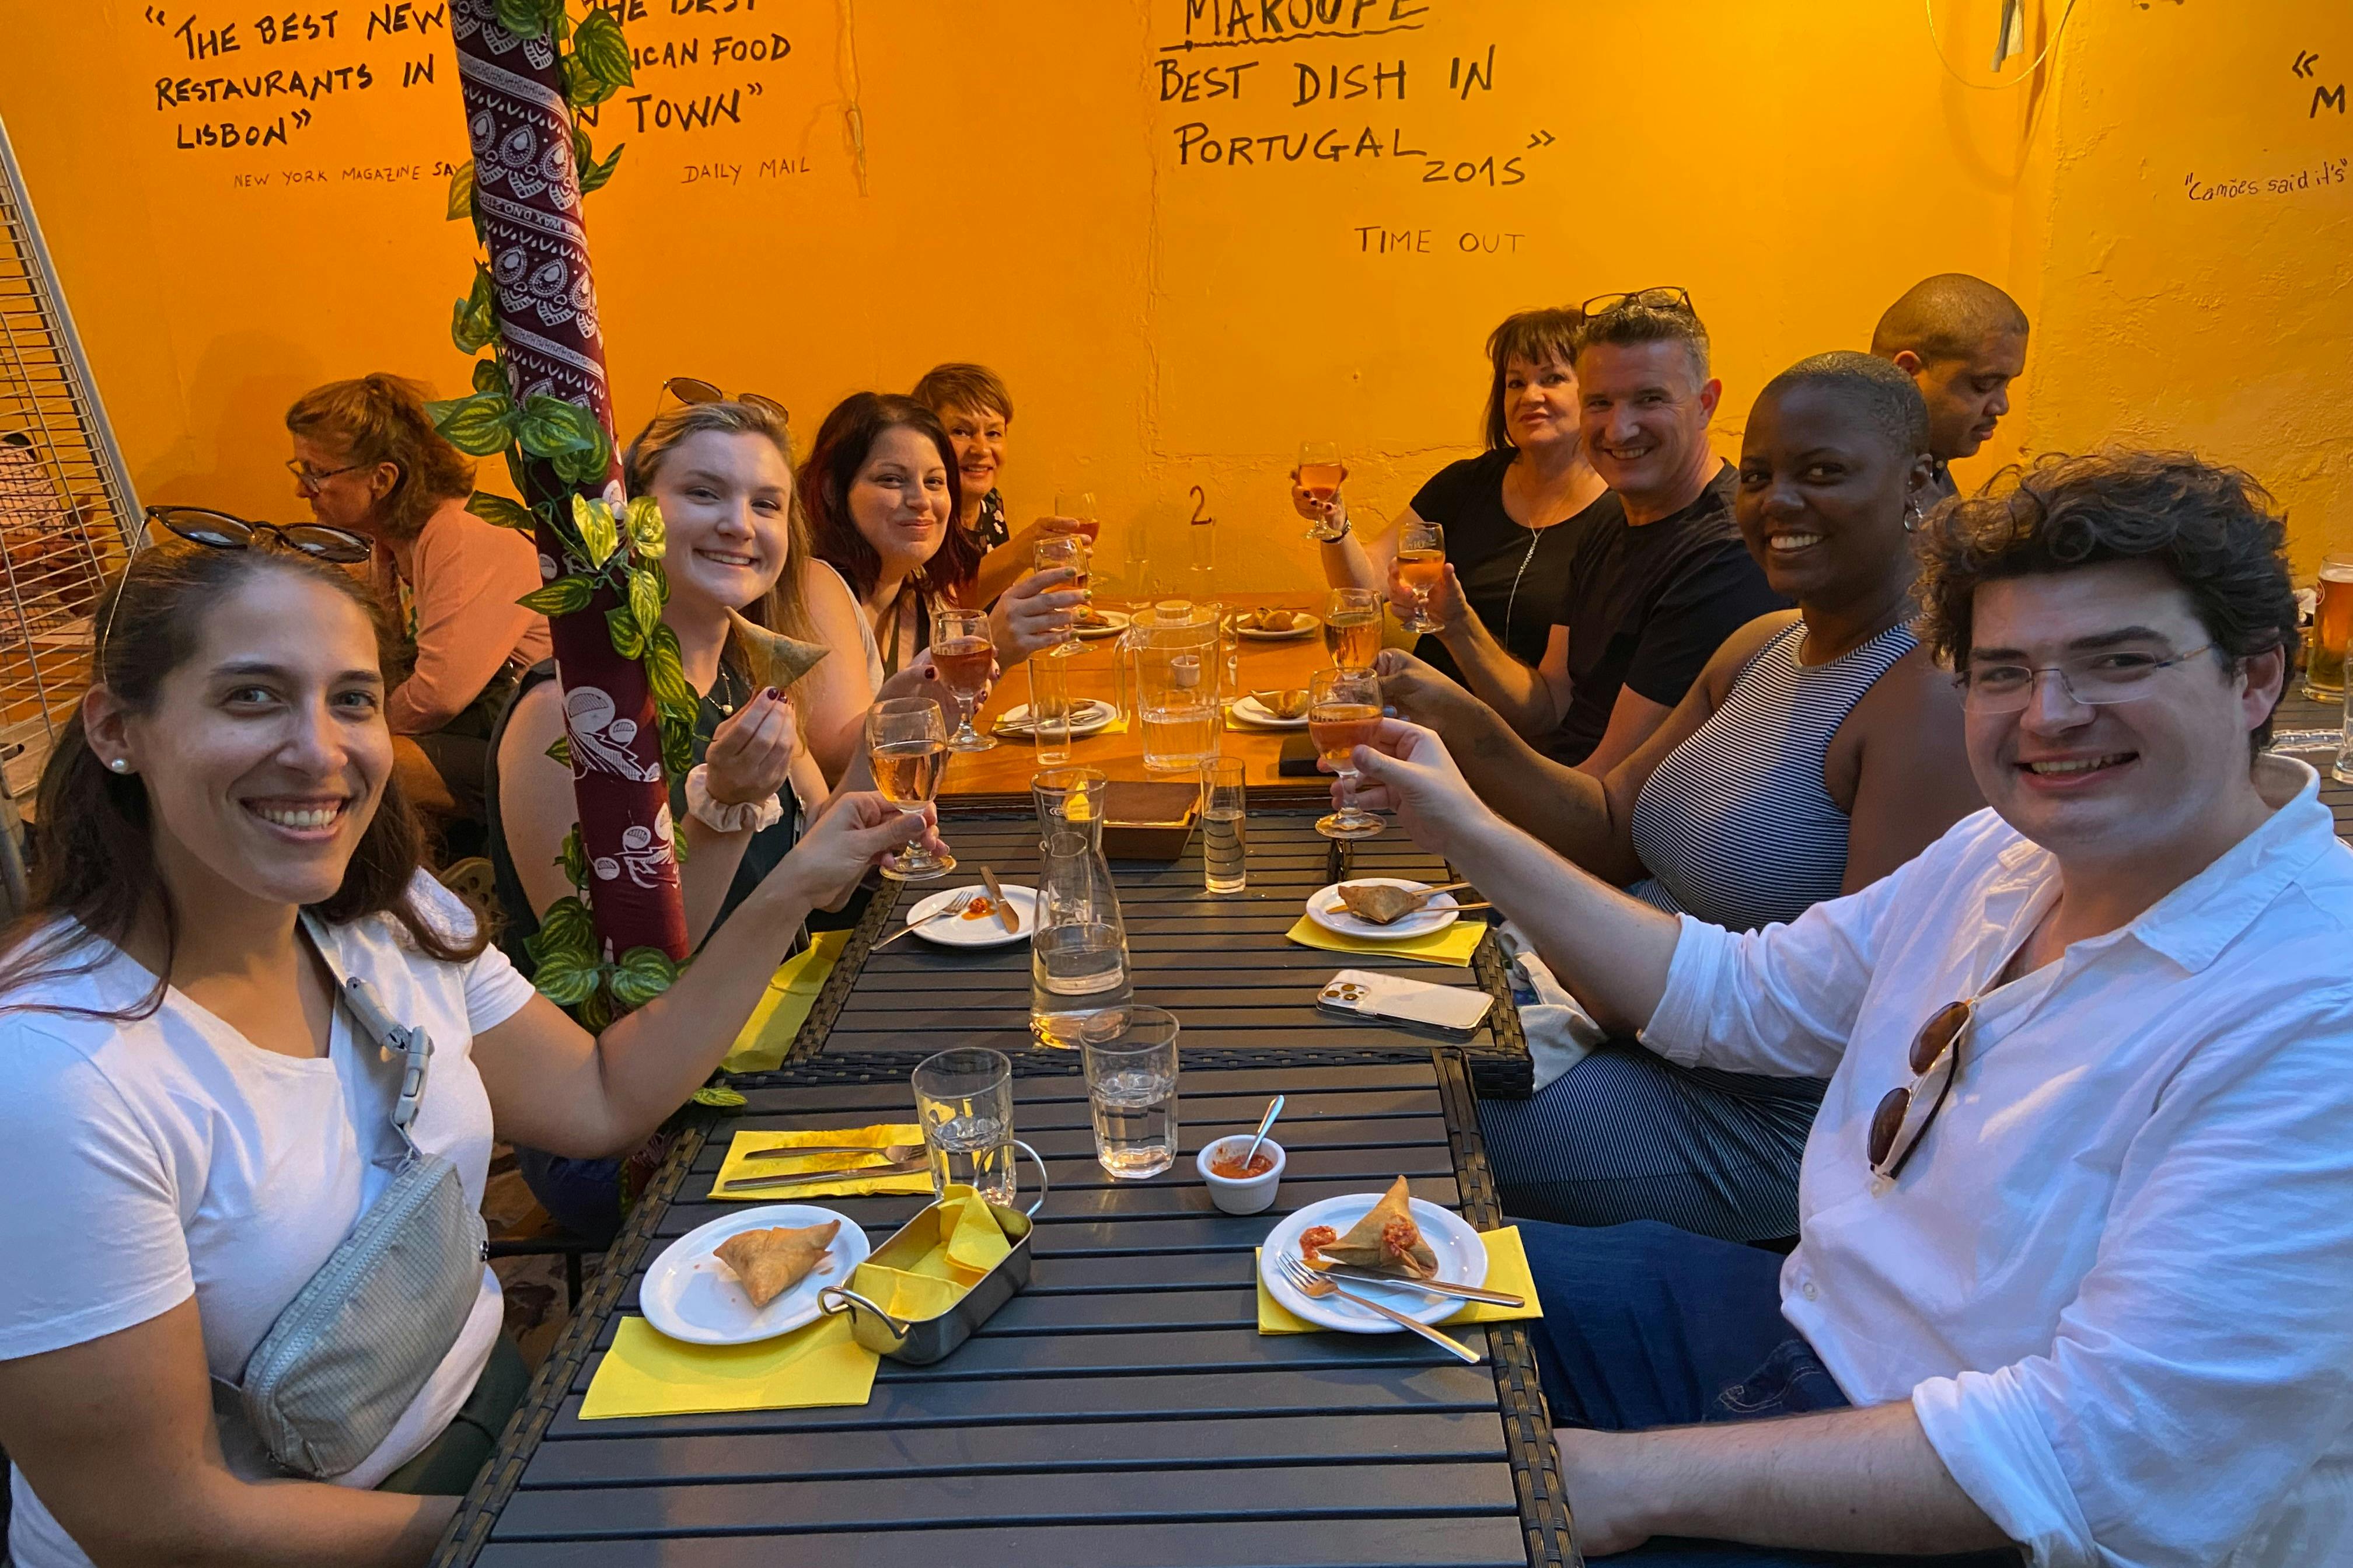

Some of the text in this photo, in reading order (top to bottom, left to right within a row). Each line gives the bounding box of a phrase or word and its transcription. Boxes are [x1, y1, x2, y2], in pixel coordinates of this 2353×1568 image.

[254, 10, 338, 45] BEST
[366, 3, 445, 41] NEW
[712, 33, 791, 65] FOOD
[155, 53, 434, 111] RESTAURANTS IN
[1154, 44, 1496, 107] BEST DISH IN
[1174, 122, 1427, 166] PORTUGAL
[234, 174, 269, 187] NEW
[282, 170, 327, 186] YORK
[343, 165, 420, 182] MAGAZINE
[681, 156, 810, 186] DAILY MAIL
[2268, 170, 2309, 193] said
[1354, 226, 1525, 254] TIME OUT
[1190, 485, 1212, 525] 2
